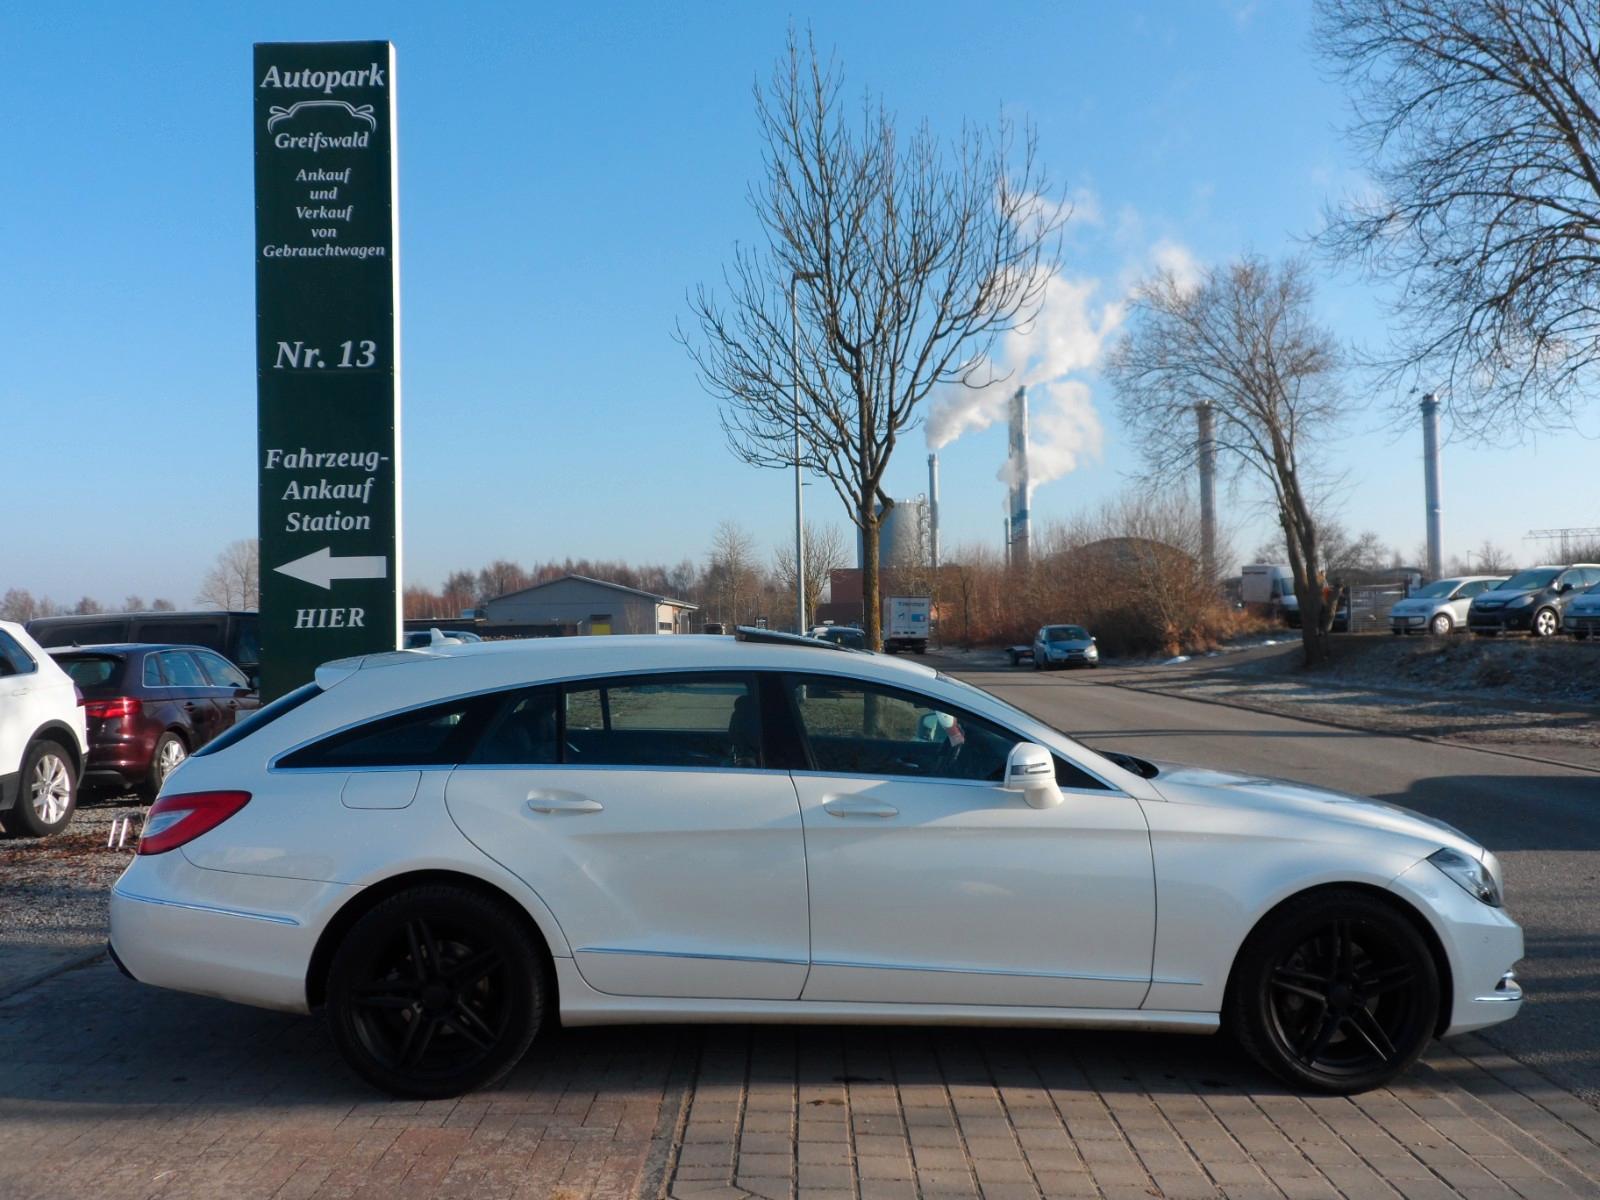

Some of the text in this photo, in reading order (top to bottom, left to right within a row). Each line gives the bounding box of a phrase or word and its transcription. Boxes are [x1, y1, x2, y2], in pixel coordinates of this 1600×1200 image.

[260, 63, 385, 94] Autopark
[274, 131, 369, 152] Greifswald
[295, 168, 352, 184] Ankauf
[309, 187, 338, 200] und
[295, 205, 354, 221] Verkauf
[311, 228, 337, 238] von
[263, 244, 385, 259] Gebrauchtwagen
[273, 340, 377, 369] Nr. 13
[264, 447, 389, 472] Fahrzeug-
[281, 477, 376, 504] Ankauf
[285, 510, 371, 533] Station
[294, 607, 366, 629] HIER
